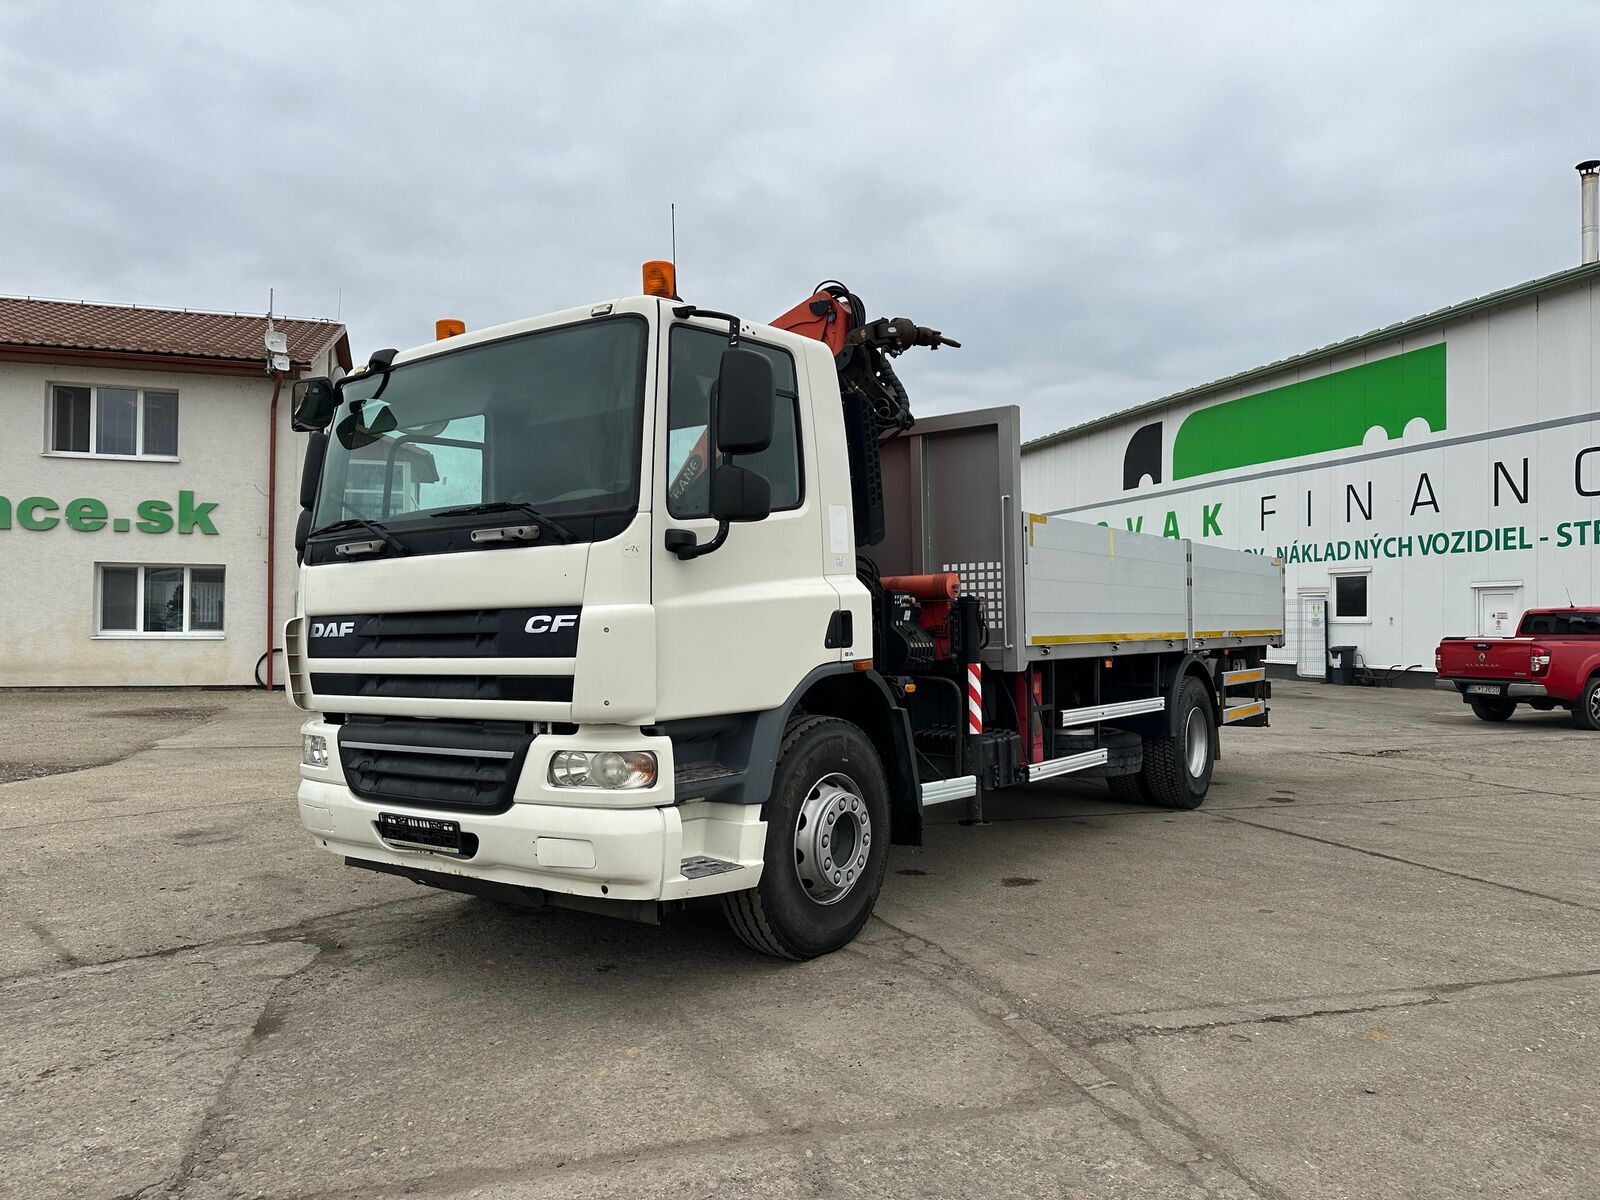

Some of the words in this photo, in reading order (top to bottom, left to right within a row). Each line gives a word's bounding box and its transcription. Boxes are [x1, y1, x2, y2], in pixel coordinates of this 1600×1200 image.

[1096, 502, 1223, 540] VAK
[1418, 526, 1533, 556] VOZIDIEL
[310, 621, 355, 638] DAF
[524, 614, 578, 633] CF
